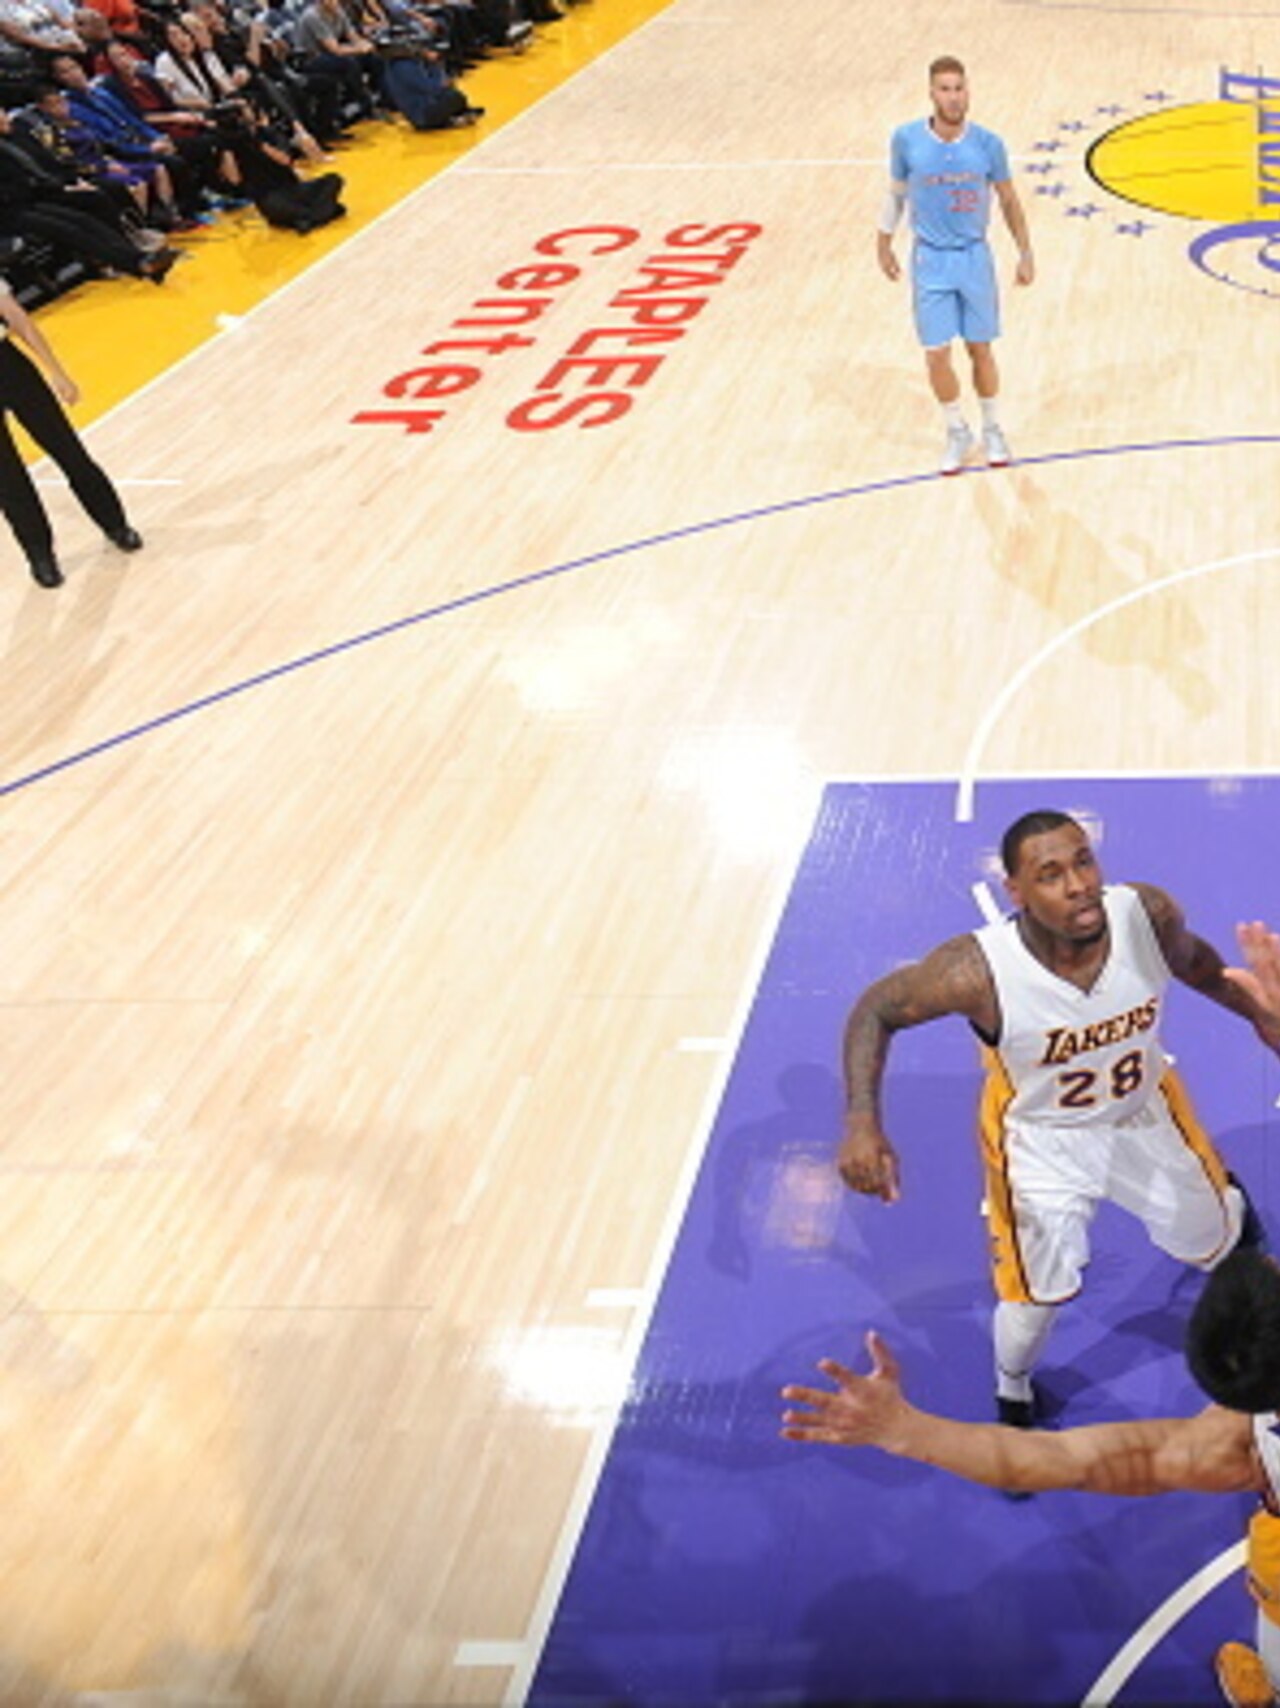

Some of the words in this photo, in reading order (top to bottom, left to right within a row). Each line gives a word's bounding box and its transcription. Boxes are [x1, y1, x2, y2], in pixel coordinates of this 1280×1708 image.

[348, 224, 641, 435] Center
[505, 221, 763, 433] STAPLES
[1035, 994, 1159, 1067] LAKERS
[1057, 1048, 1145, 1109] 28
